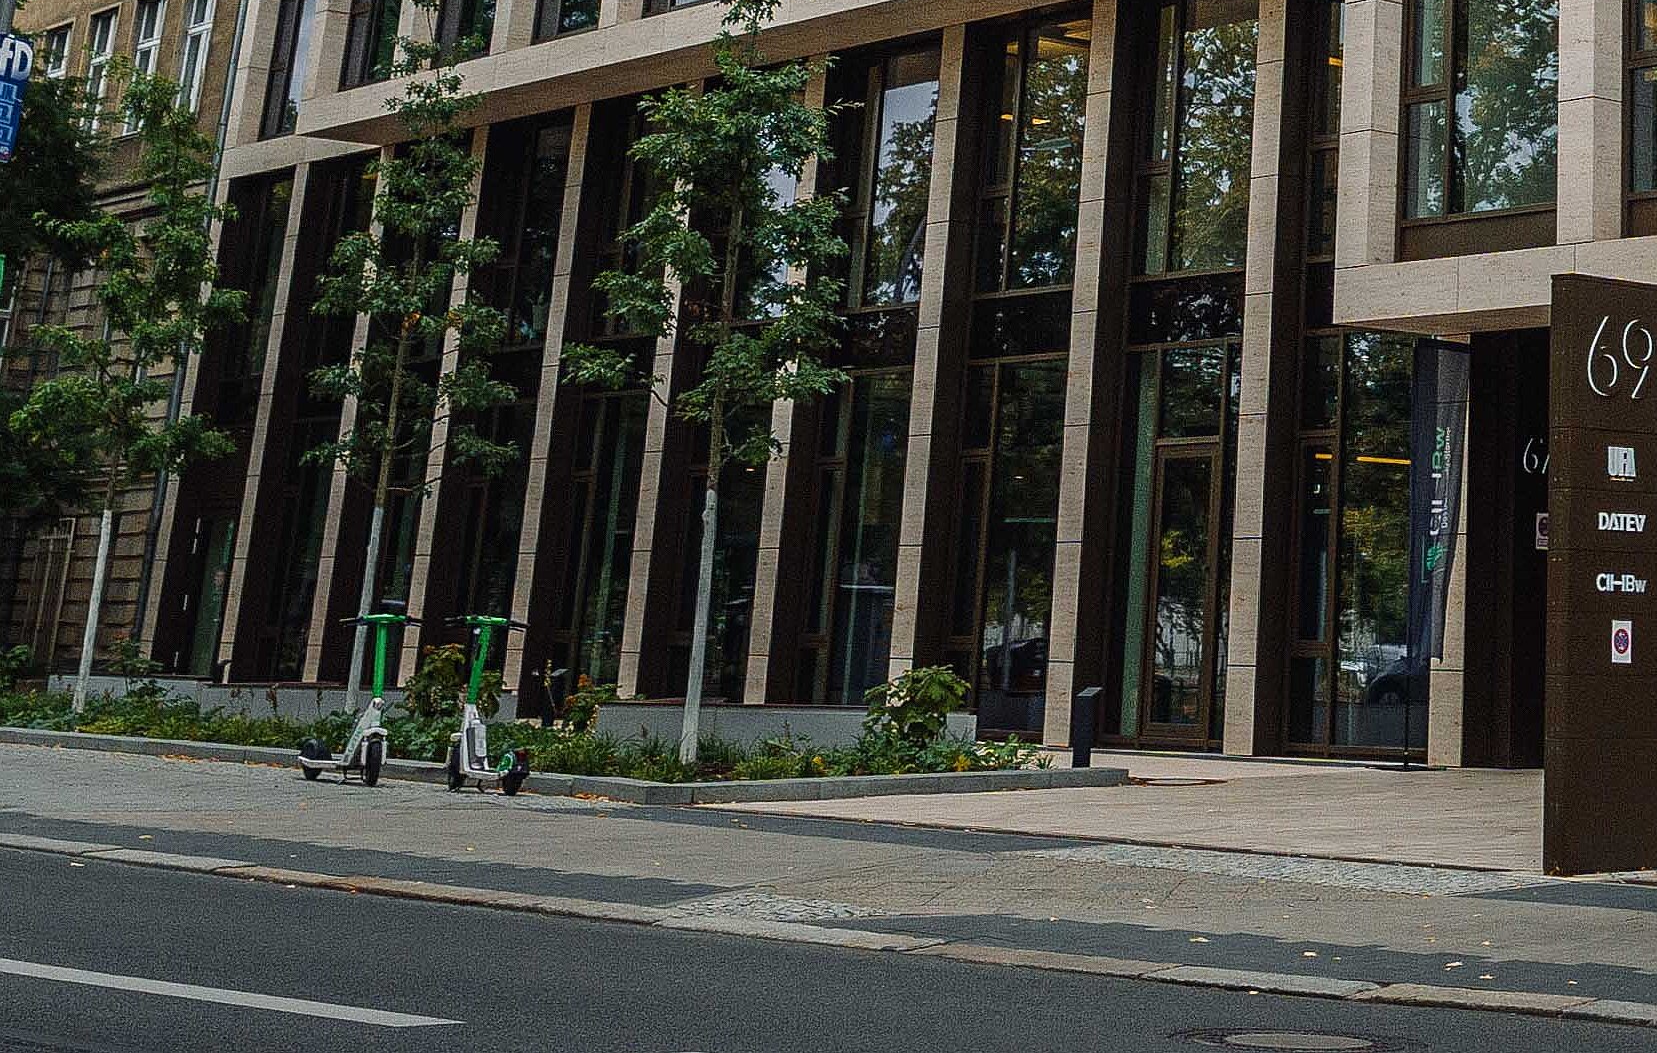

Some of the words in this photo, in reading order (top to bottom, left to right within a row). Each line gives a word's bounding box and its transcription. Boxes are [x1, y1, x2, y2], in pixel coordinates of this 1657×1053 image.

[0, 36, 33, 81] fD
[1587, 315, 1654, 400] 69
[1598, 512, 1647, 532] DATEV
